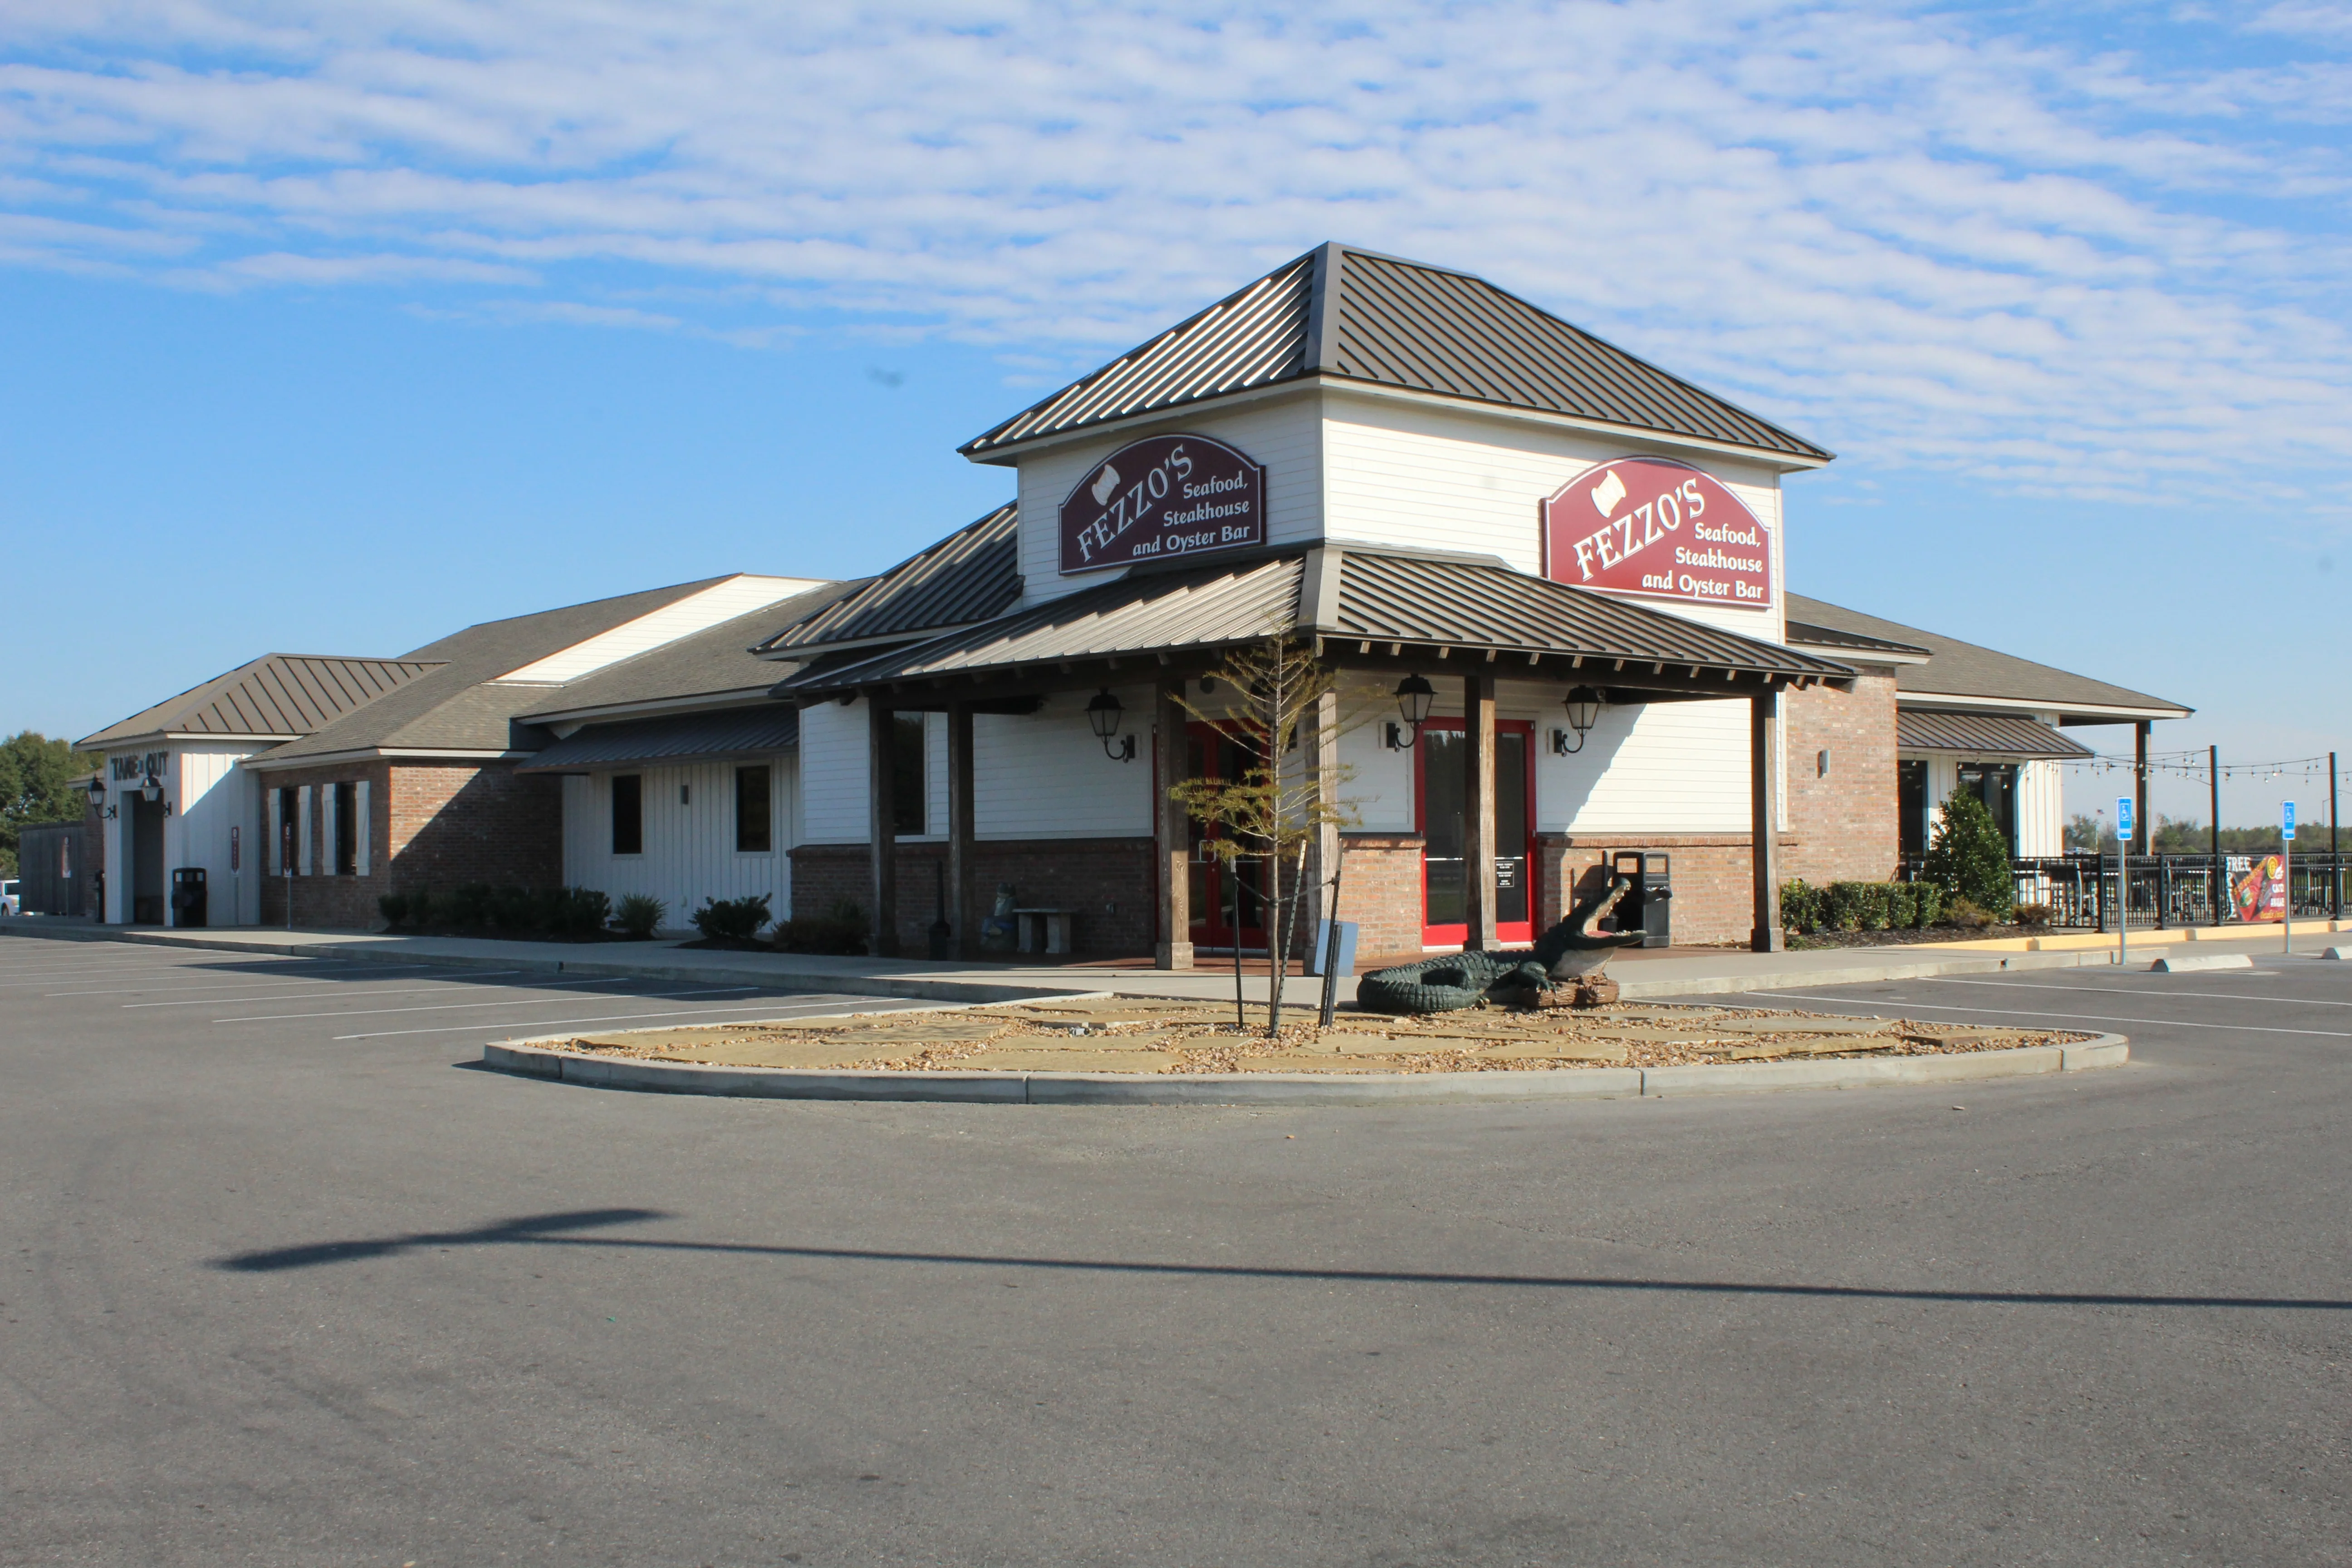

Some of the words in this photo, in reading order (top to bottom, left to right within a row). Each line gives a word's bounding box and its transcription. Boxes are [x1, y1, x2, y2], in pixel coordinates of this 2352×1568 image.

[1183, 470, 1249, 499] Seafood,
[1077, 444, 1193, 563] FEZZO'S
[1163, 500, 1250, 527] Steakhouse
[1133, 535, 1161, 556] and
[1166, 531, 1216, 553] Oyster
[1221, 526, 1250, 542] Bar
[1573, 478, 1705, 582] FEZZO'S
[1695, 522, 1761, 547] Seafood,
[1675, 546, 1763, 573] Steakhouse
[1642, 570, 1673, 590] and
[1679, 574, 1730, 598] Oyster
[1735, 581, 1763, 599] Bar
[2226, 856, 2251, 872] FREE
